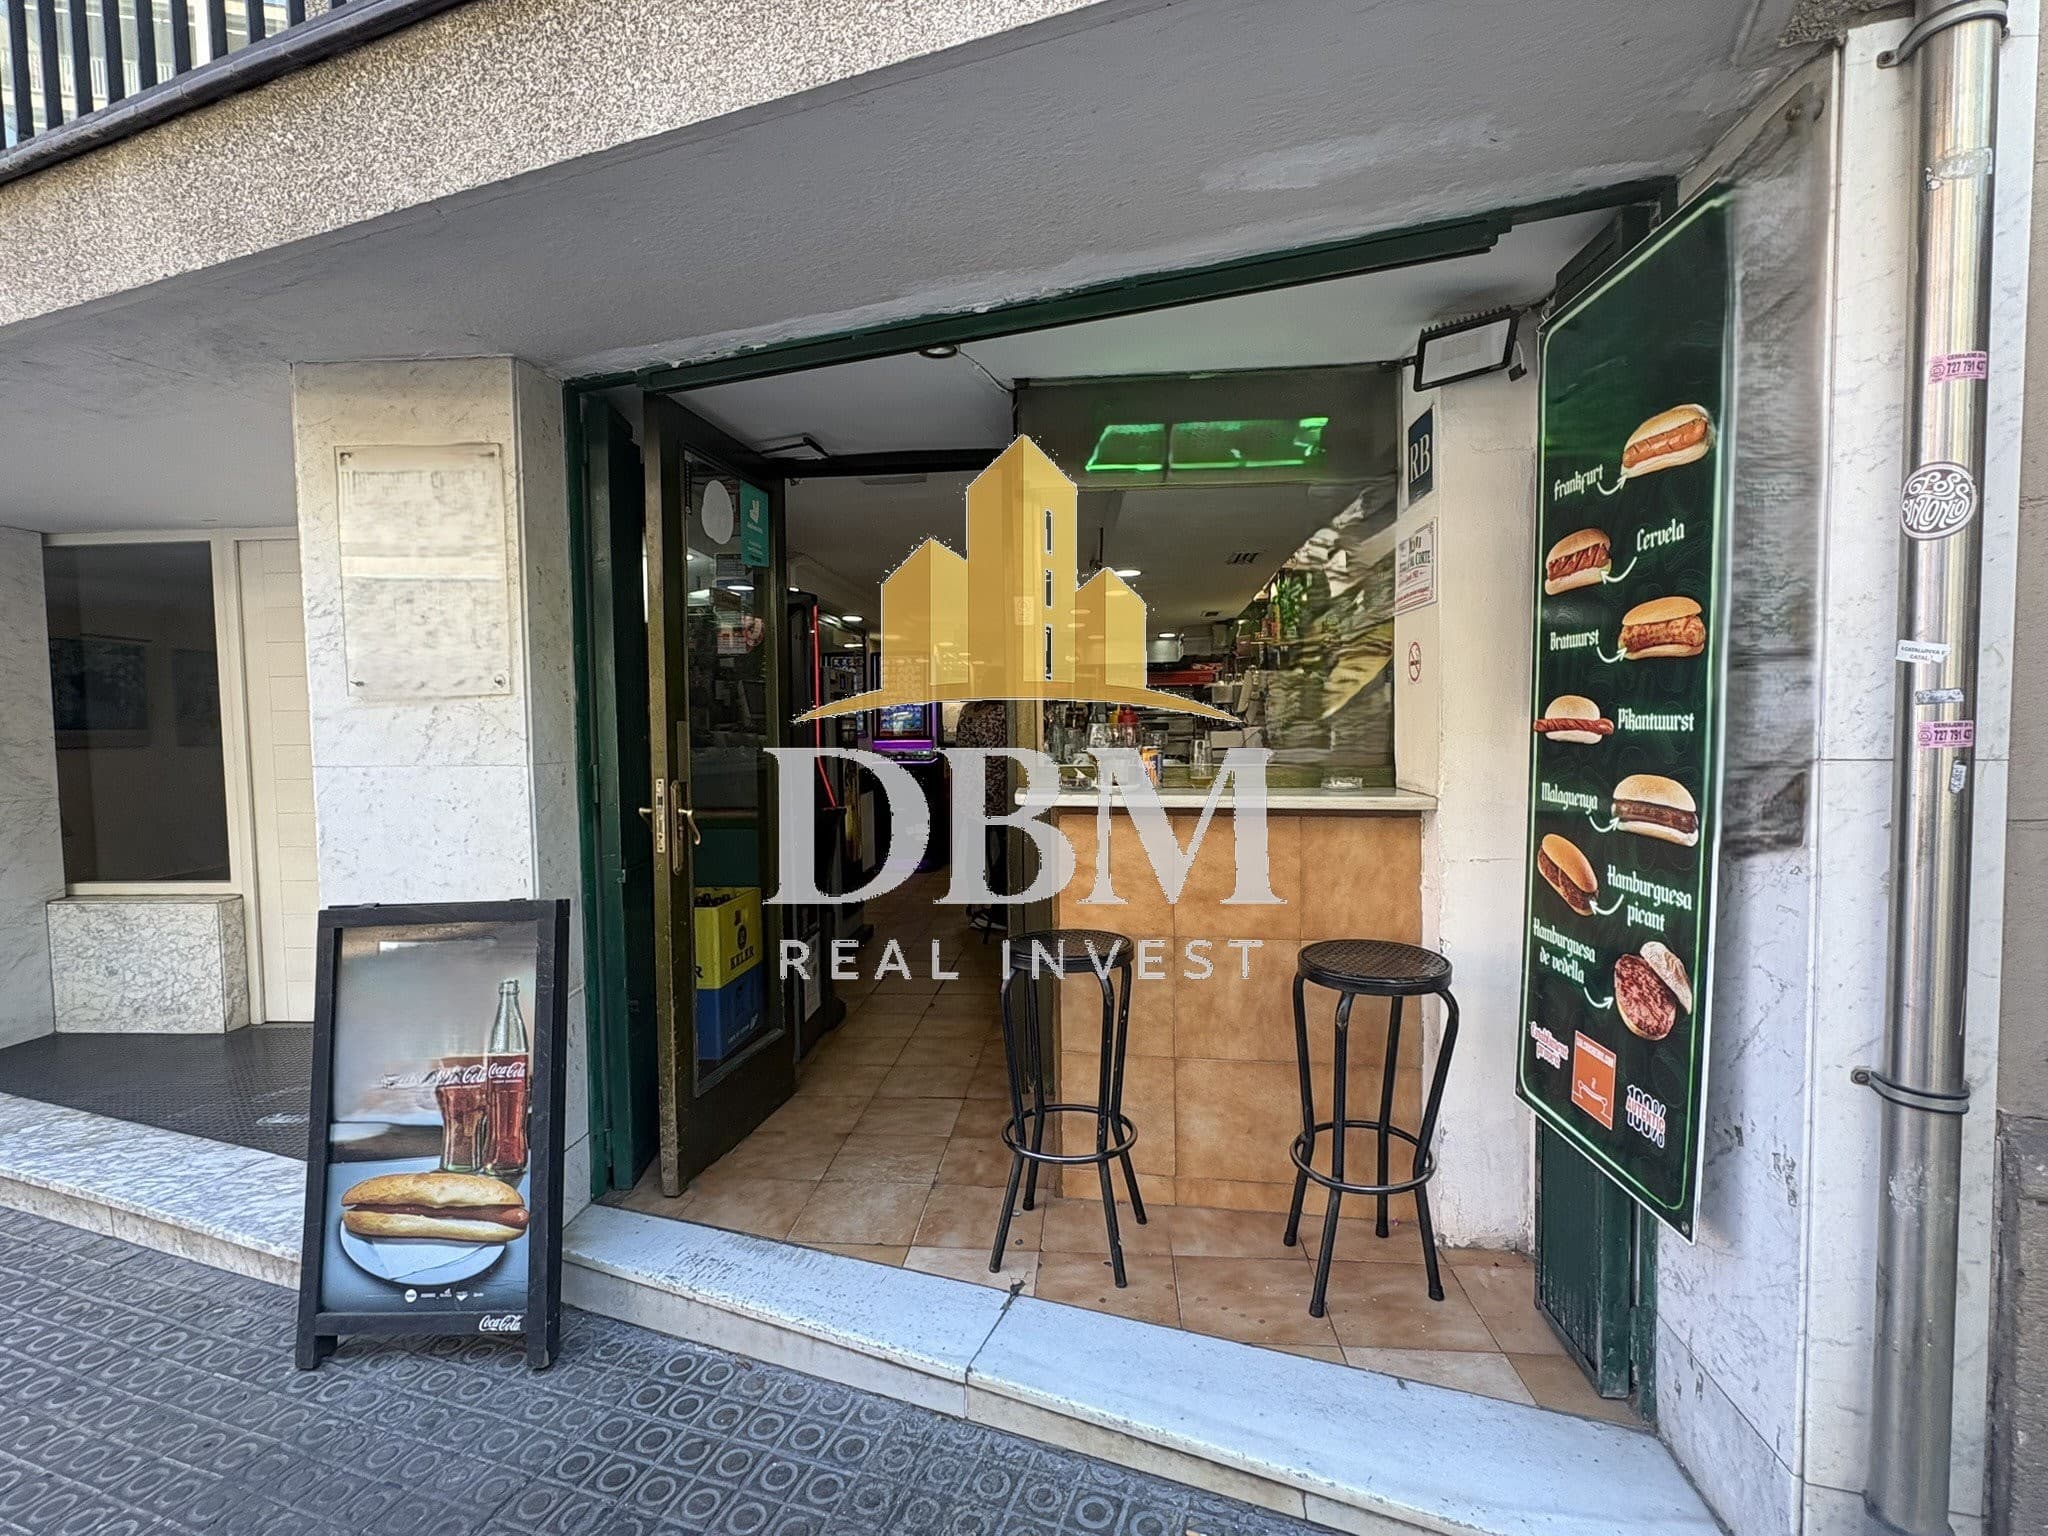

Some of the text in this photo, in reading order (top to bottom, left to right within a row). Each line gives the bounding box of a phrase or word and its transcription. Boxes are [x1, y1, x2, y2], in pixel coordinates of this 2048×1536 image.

[1409, 433, 1431, 483] RB
[1637, 518, 1685, 552] Cervela
[1550, 629, 1599, 651] Bratwurst
[1618, 708, 1695, 731] Pikantwurst
[1542, 782, 1598, 815] Malaguenya
[1607, 864, 1692, 911] Hamburguesa
[1627, 902, 1665, 932] picant
[1533, 916, 1596, 963] Hamburguesa
[1539, 946, 1586, 985] de vedella
